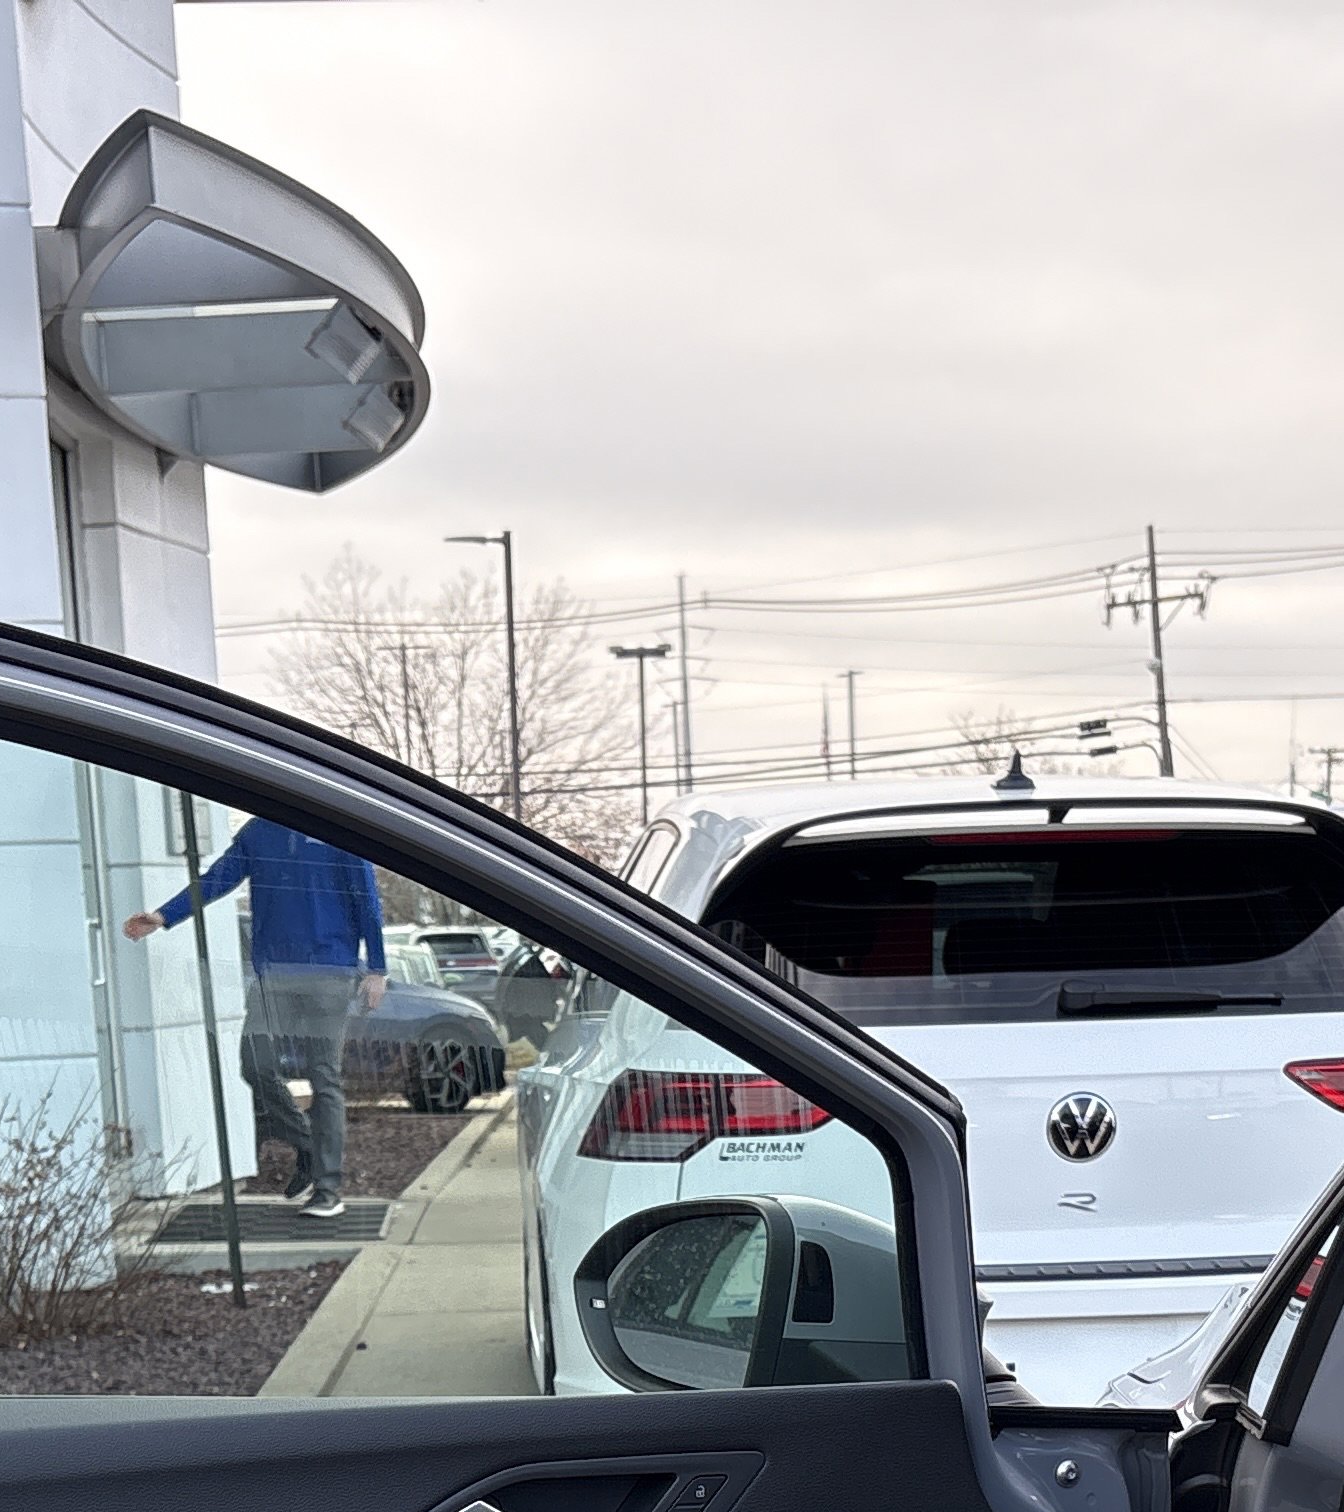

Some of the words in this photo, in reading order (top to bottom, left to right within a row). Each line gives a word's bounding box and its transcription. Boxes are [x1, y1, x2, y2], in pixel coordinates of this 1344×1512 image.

[726, 1142, 805, 1153] BACHMAN
[729, 1154, 760, 1162] AUTO
[763, 1154, 802, 1162] GROUP
